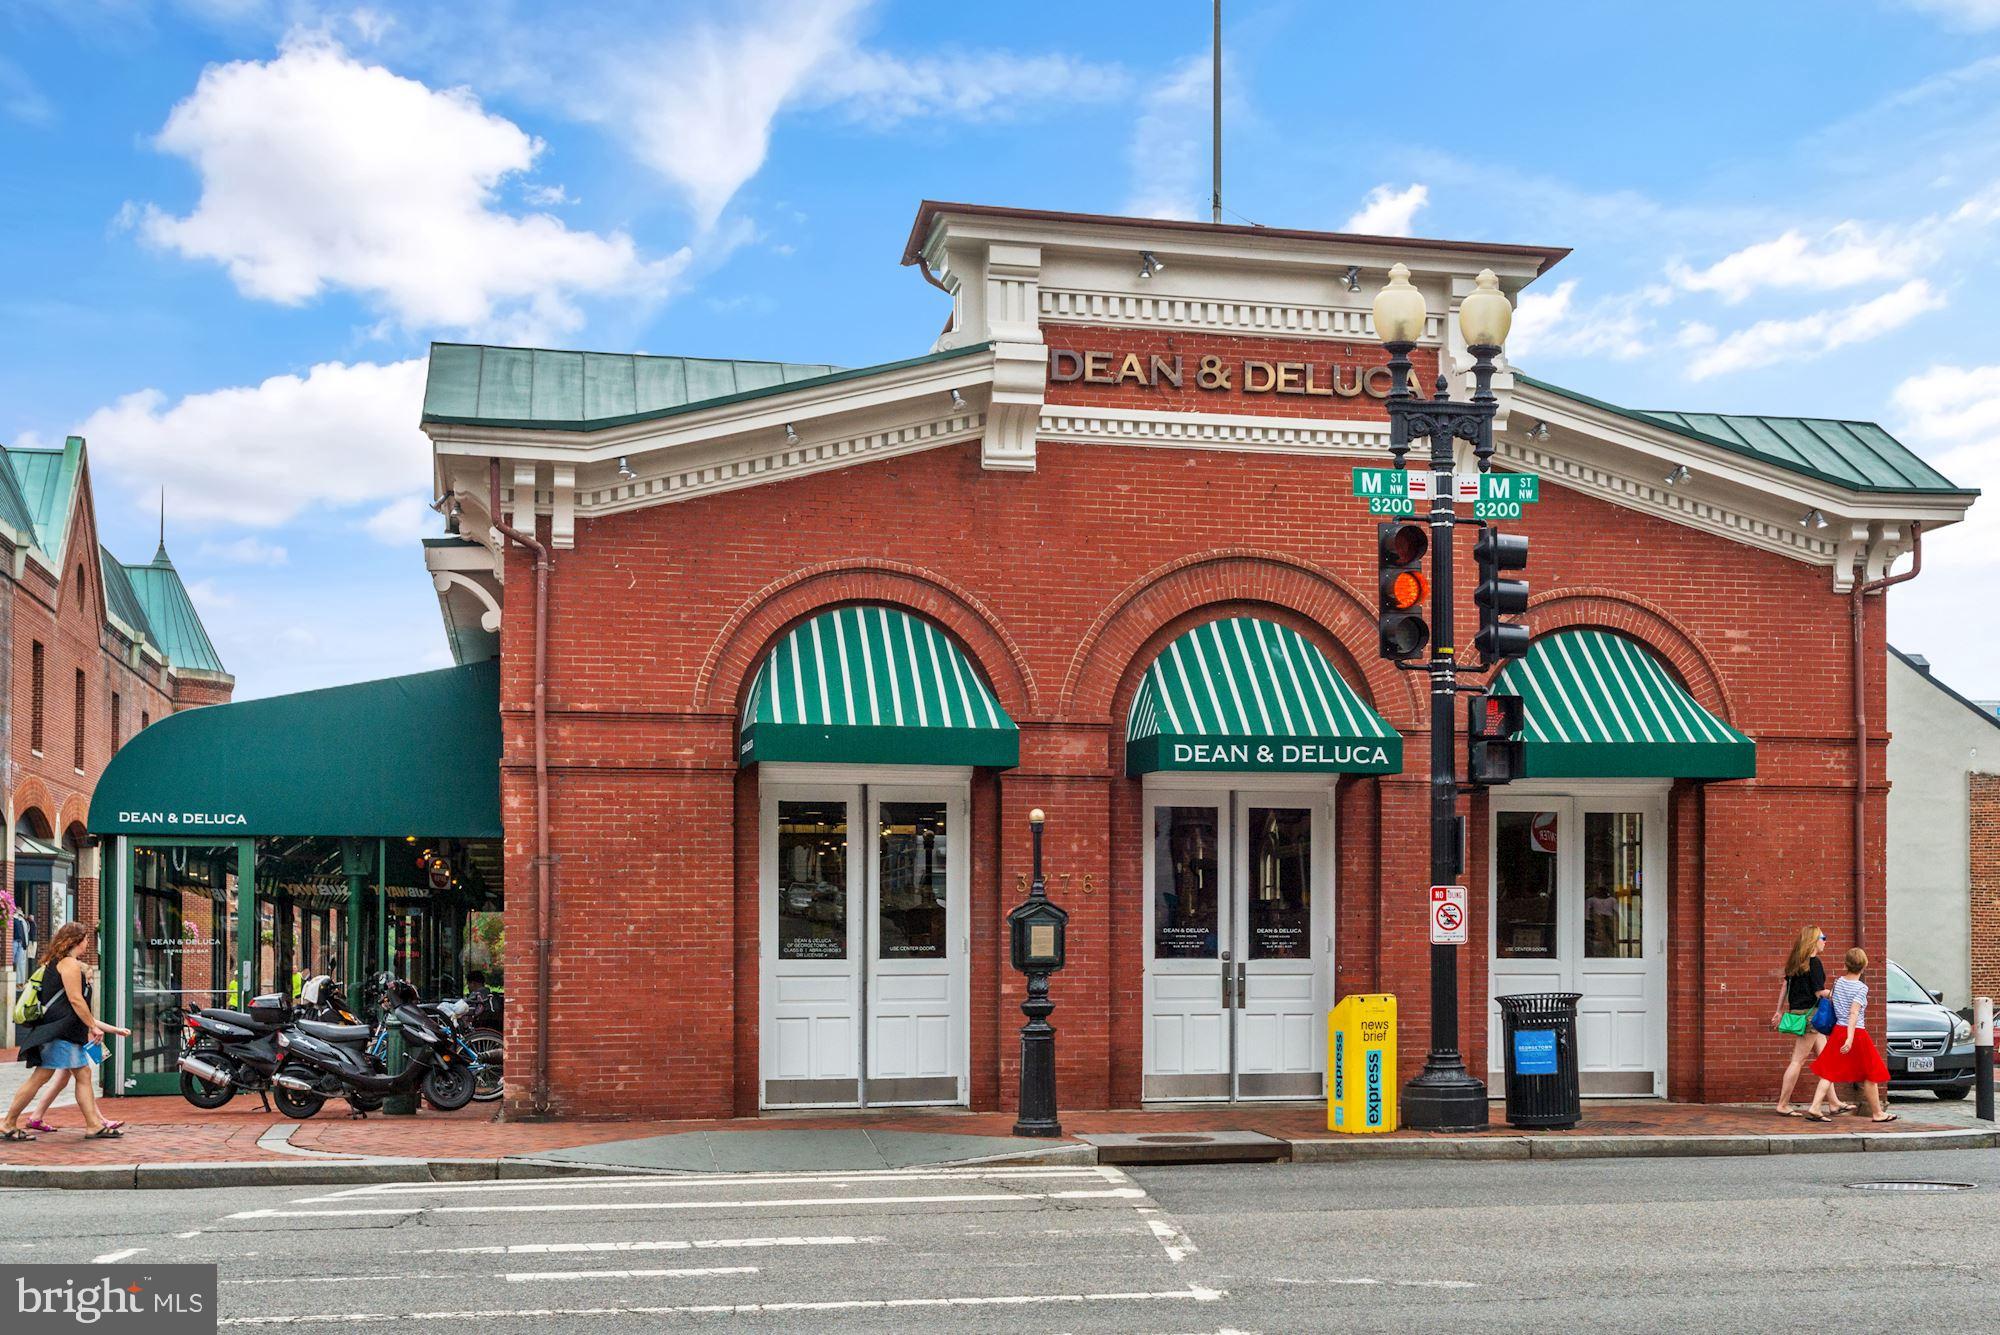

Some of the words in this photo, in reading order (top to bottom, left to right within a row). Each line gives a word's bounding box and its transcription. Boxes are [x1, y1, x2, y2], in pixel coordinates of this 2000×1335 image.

[1050, 348, 1183, 388] DEAN
[1196, 354, 1232, 390] &
[1242, 359, 1425, 401] DELUCA
[1362, 472, 1382, 493] M
[1391, 473, 1402, 484] ST
[1389, 484, 1403, 495] NW
[1489, 478, 1510, 498] M
[1520, 477, 1532, 488] ST
[1518, 489, 1533, 500] NW
[1371, 498, 1413, 513] 3200
[1475, 502, 1520, 517] 3200
[1174, 744, 1249, 763] DEAN
[1256, 745, 1274, 763] &
[1282, 745, 1389, 765] DELUCA
[119, 812, 163, 823] DEAN
[167, 813, 179, 824] &
[182, 813, 247, 825] DELUCA
[1435, 890, 1444, 899] NO
[1361, 1019, 1389, 1030] news
[1363, 1031, 1387, 1042] brief
[1335, 1034, 1343, 1098] express
[1368, 1053, 1382, 1125] express
